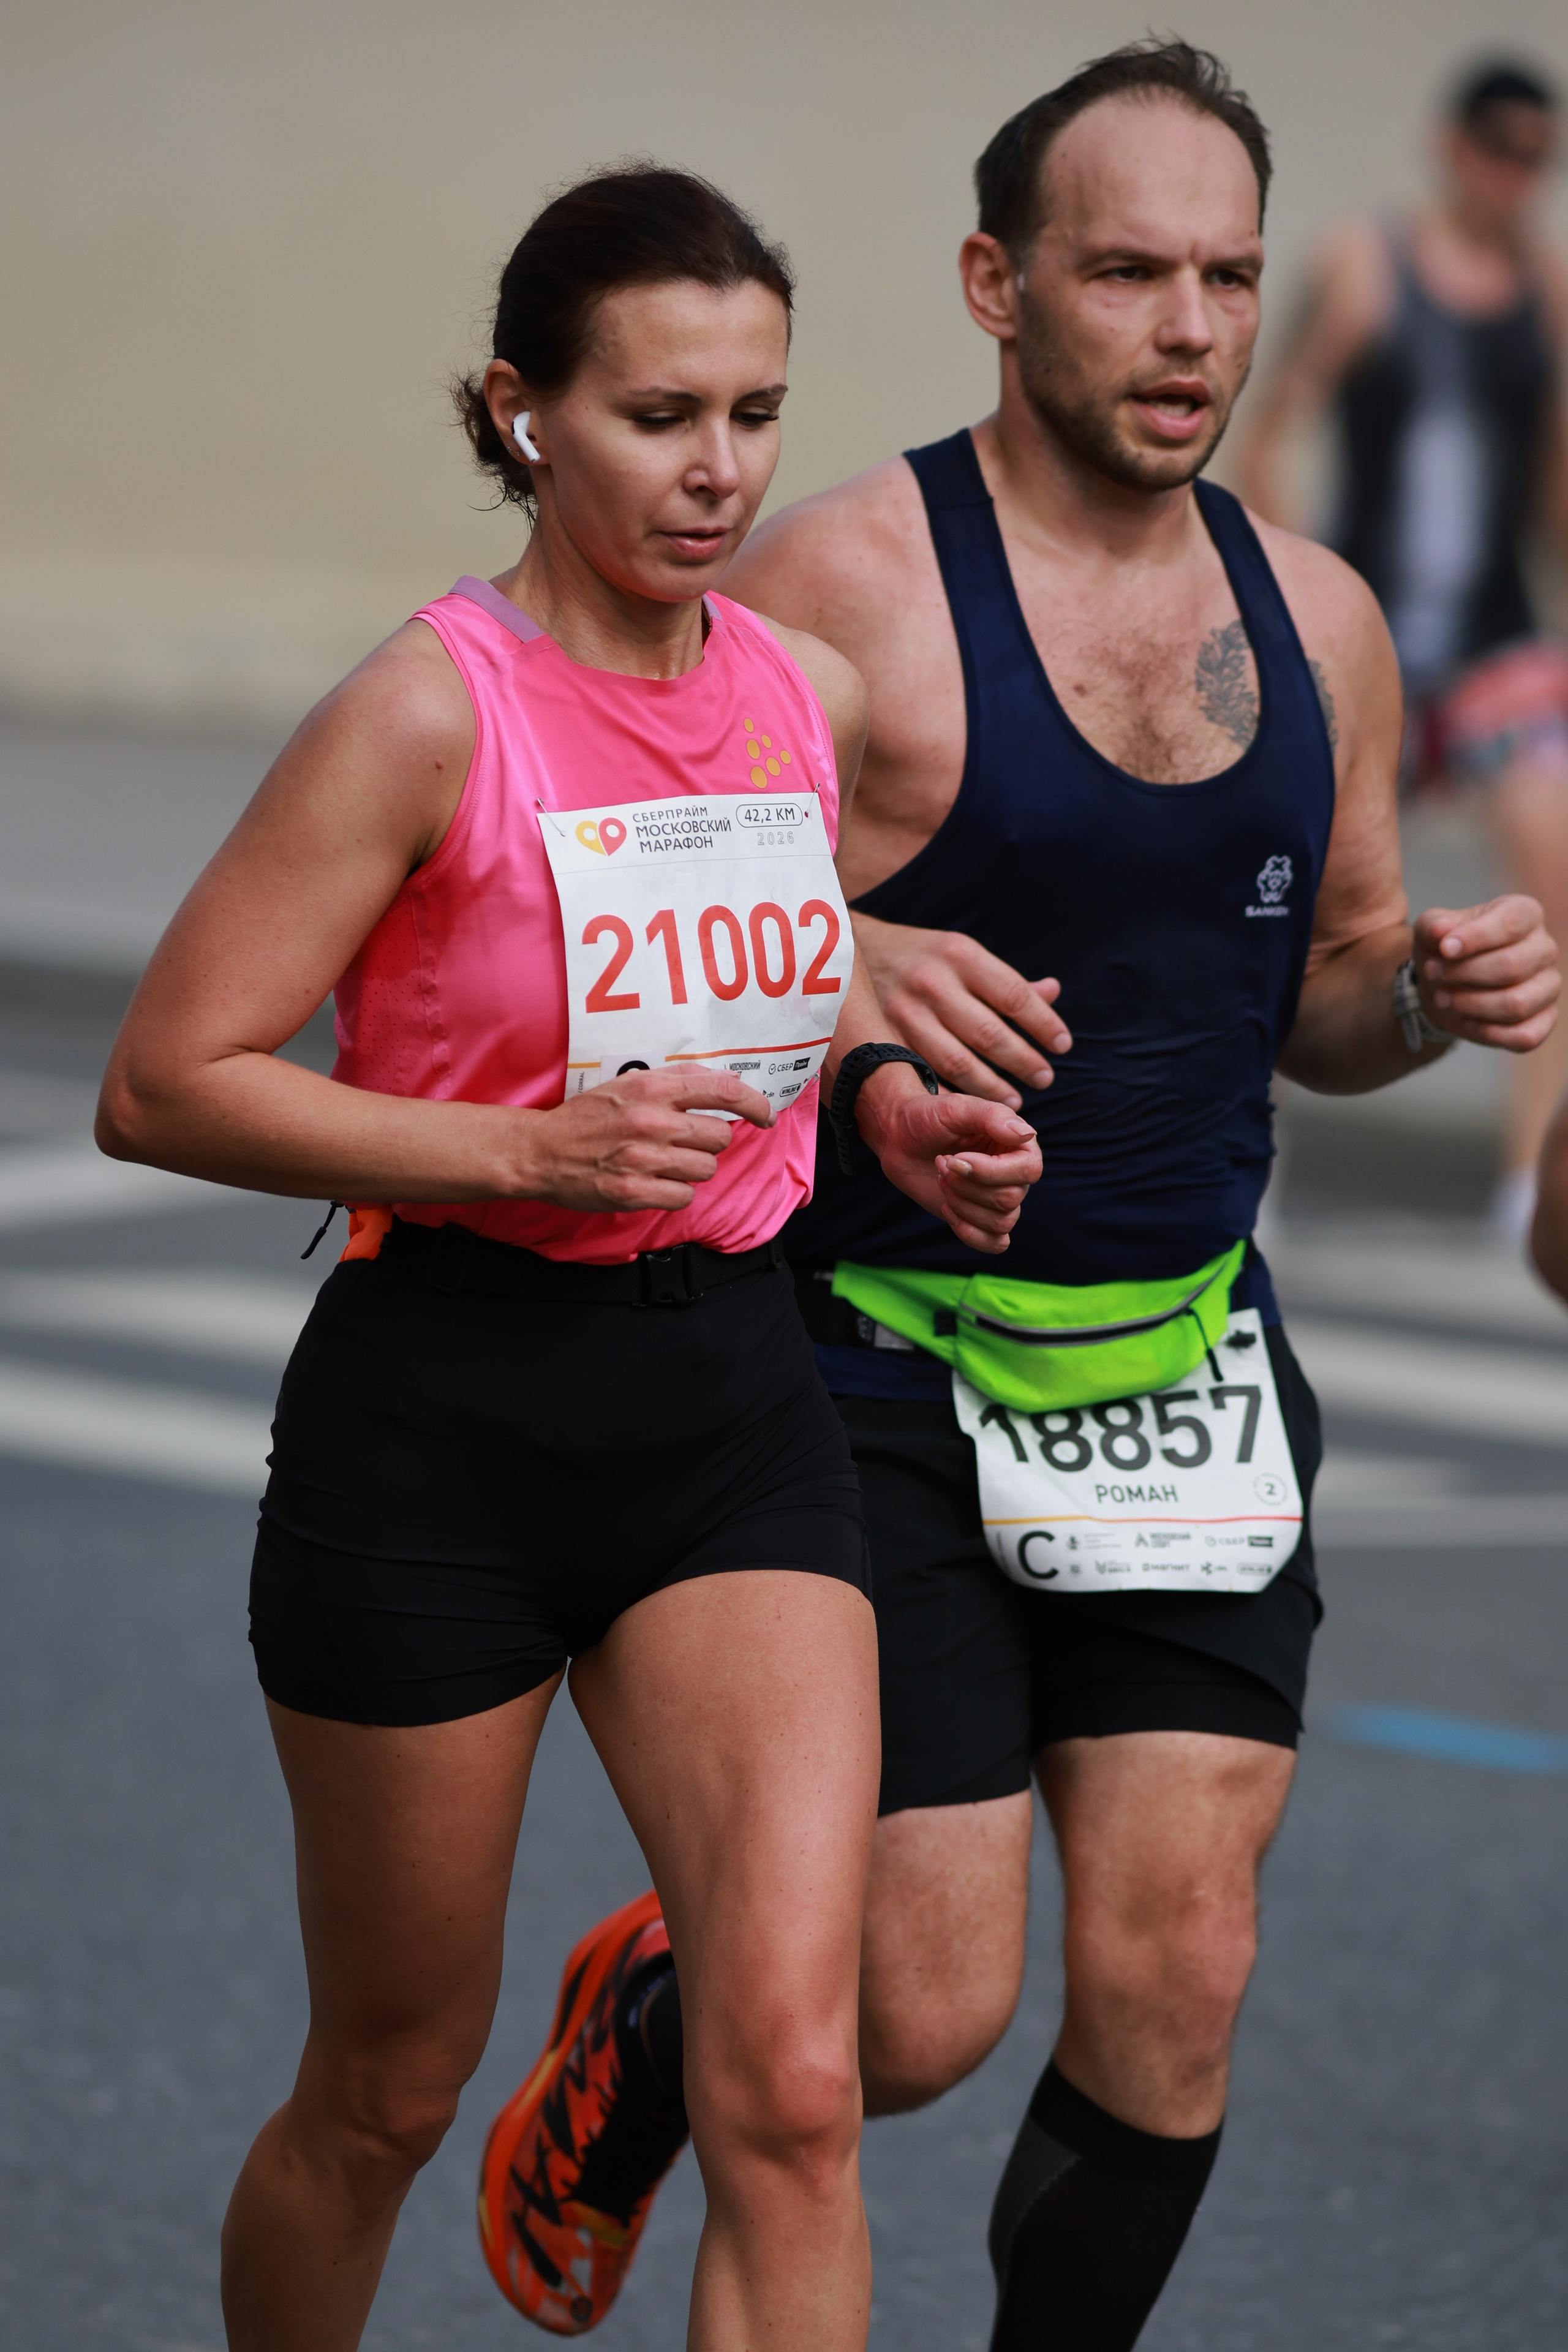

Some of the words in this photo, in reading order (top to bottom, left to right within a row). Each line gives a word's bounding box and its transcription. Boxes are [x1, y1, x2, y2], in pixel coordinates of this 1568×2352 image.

[633, 805, 708, 823] СБЕРПРАЙМ
[744, 809, 772, 823] 42,2
[776, 808, 795, 821] КМ
[636, 818, 732, 838] МОСКОВСКИЙ
[639, 836, 714, 853] МАРАФОН
[757, 831, 794, 845] 2026
[581, 899, 842, 1014] 21002
[729, 1060, 761, 1071] МОСКОВСКИЙ
[777, 1063, 793, 1072] СБЕР
[978, 1385, 1262, 1472] 18857
[1095, 1484, 1178, 1503] РОМАН
[1264, 1482, 1277, 1496] 2
